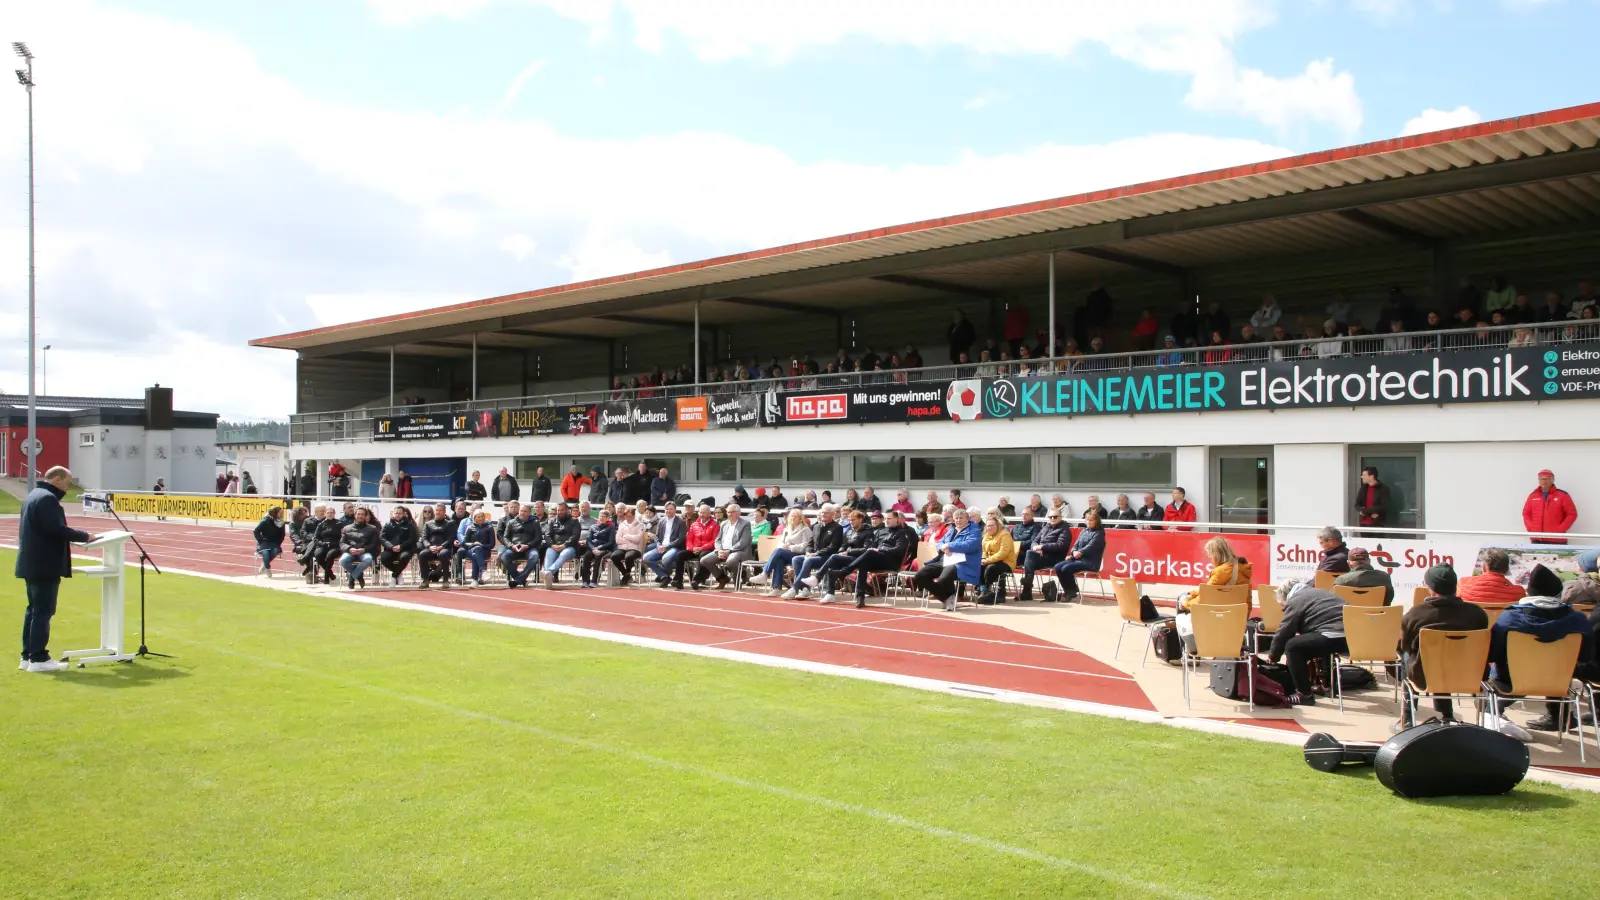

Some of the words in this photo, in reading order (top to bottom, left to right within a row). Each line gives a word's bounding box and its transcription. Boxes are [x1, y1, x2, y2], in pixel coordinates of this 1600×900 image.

[1240, 353, 1531, 406] Elektrotechnik
[853, 393, 868, 405] Mit
[869, 395, 887, 404] uns
[889, 388, 941, 406] gewinnen!
[1021, 371, 1226, 415] KLEINEMEIER
[633, 407, 669, 426] Macherei
[716, 412, 734, 425] Brote
[735, 412, 740, 423] &
[741, 408, 757, 422] mehr!
[789, 397, 844, 419] hapa
[906, 405, 941, 417] hapa.de
[379, 420, 391, 433] kIT
[453, 416, 467, 430] kIT
[511, 410, 540, 428] HAIR
[602, 409, 631, 426] Semmel
[157, 495, 212, 517] WÄRMEPUMPEN
[213, 501, 228, 518] AUS
[1115, 552, 1216, 578] Sparkass
[1404, 549, 1454, 569] Sohn
